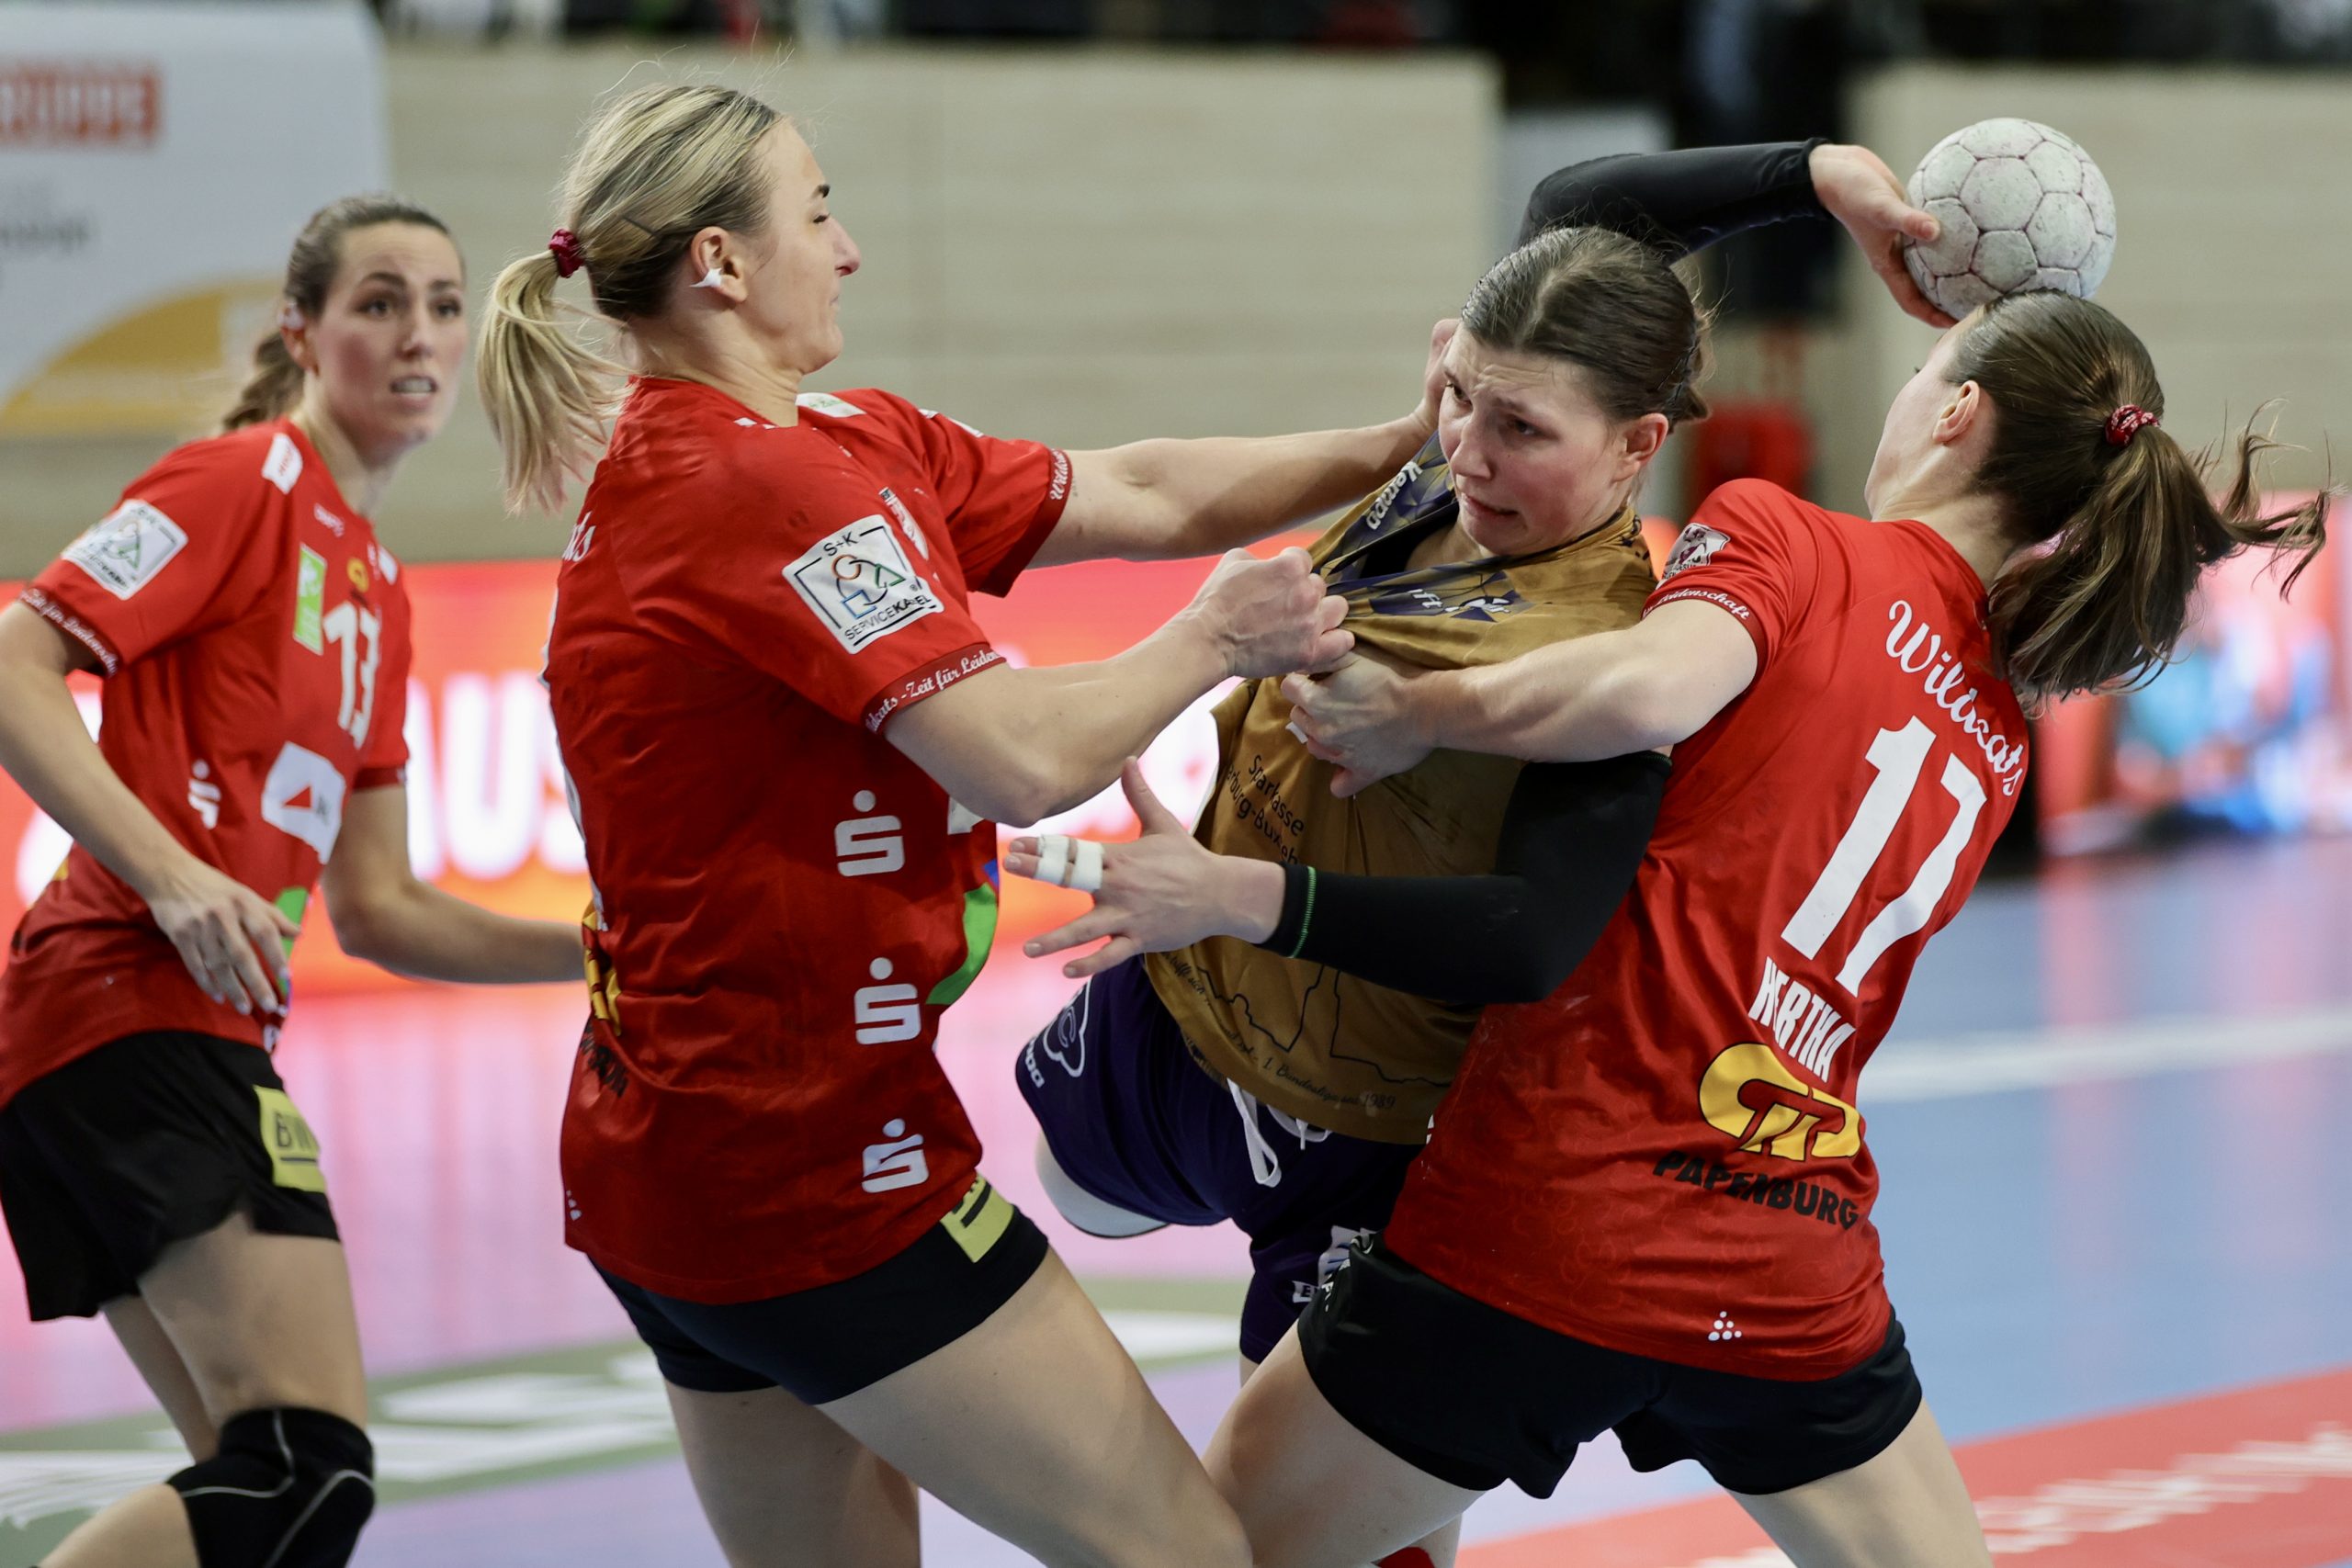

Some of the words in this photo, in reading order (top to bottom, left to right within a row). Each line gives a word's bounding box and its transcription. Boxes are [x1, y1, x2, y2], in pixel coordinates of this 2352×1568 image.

[1366, 461, 1423, 530] Kempa
[823, 531, 858, 557] S+K
[323, 601, 379, 750] 13
[935, 669, 961, 692] für
[1886, 600, 2023, 796] Wildcats
[1248, 754, 1305, 838] Sparkasse
[1781, 715, 1987, 998] 17
[1747, 955, 1858, 1084] HERTHA
[1652, 1150, 1860, 1231] PAPENBURG
